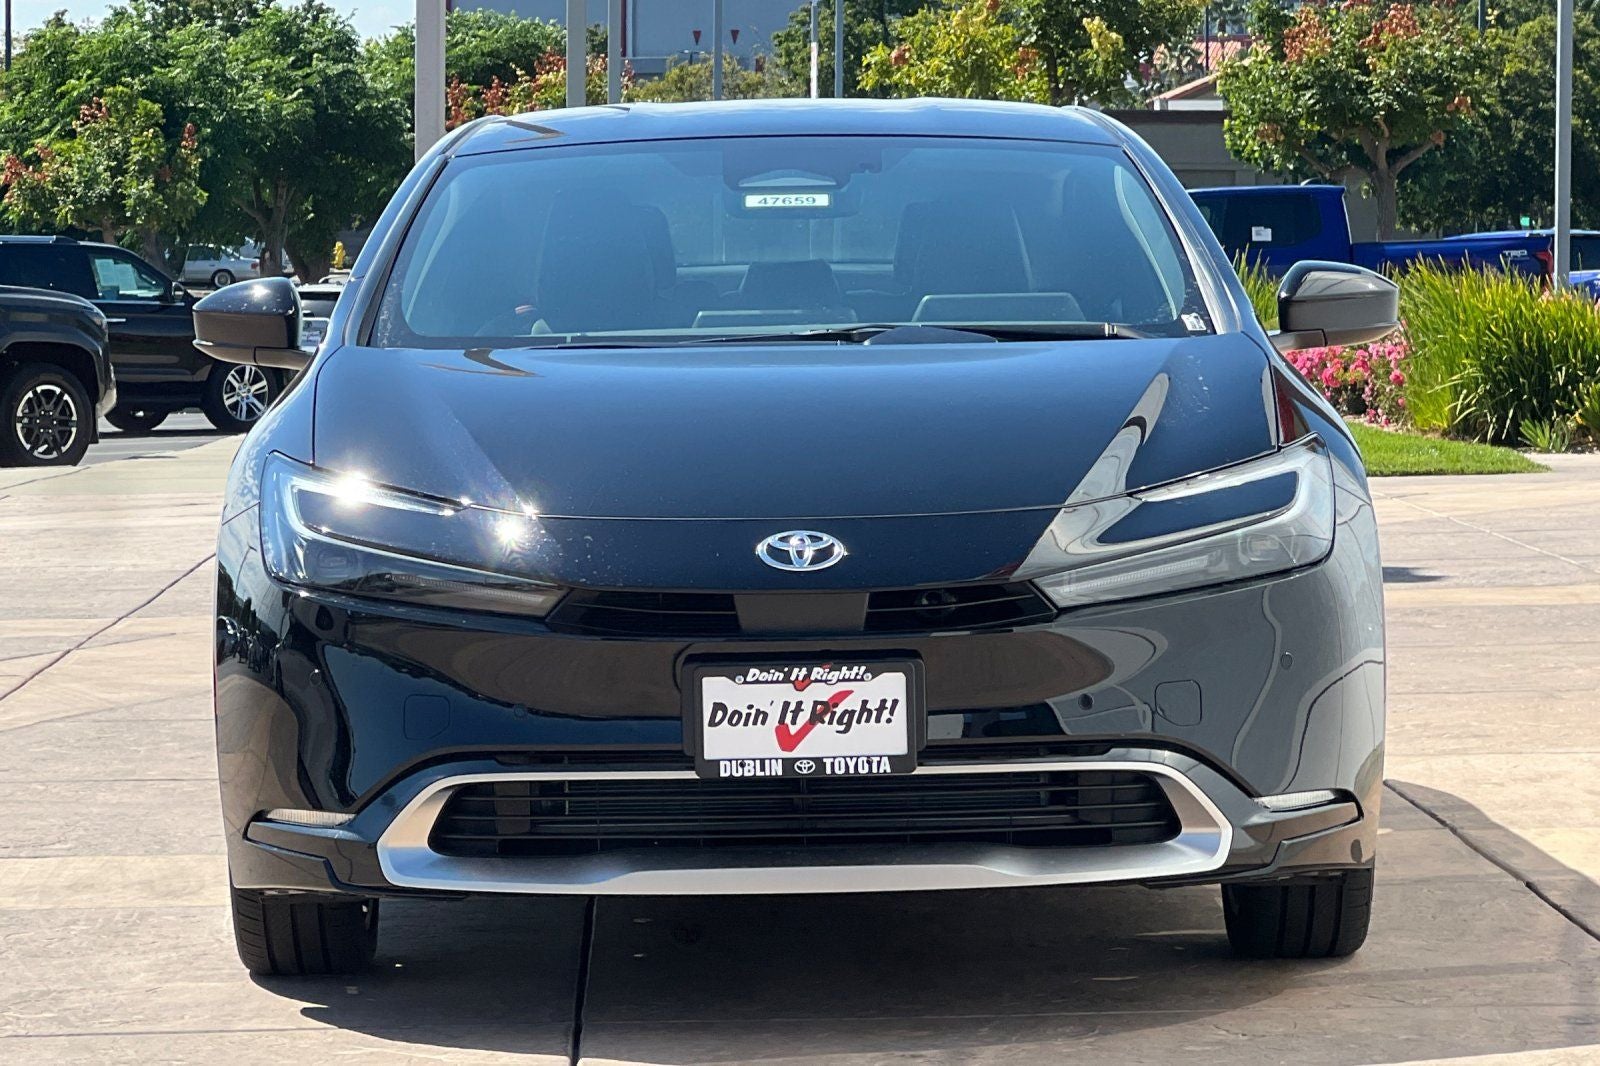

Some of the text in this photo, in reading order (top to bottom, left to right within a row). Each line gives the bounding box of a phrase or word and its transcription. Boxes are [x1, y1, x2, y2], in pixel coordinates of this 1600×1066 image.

[757, 196, 816, 206] 47659
[745, 665, 866, 685] Doin' It Right!
[708, 698, 899, 735] Doin' It Right!
[719, 756, 892, 778] DUBLIN TOYOTA
